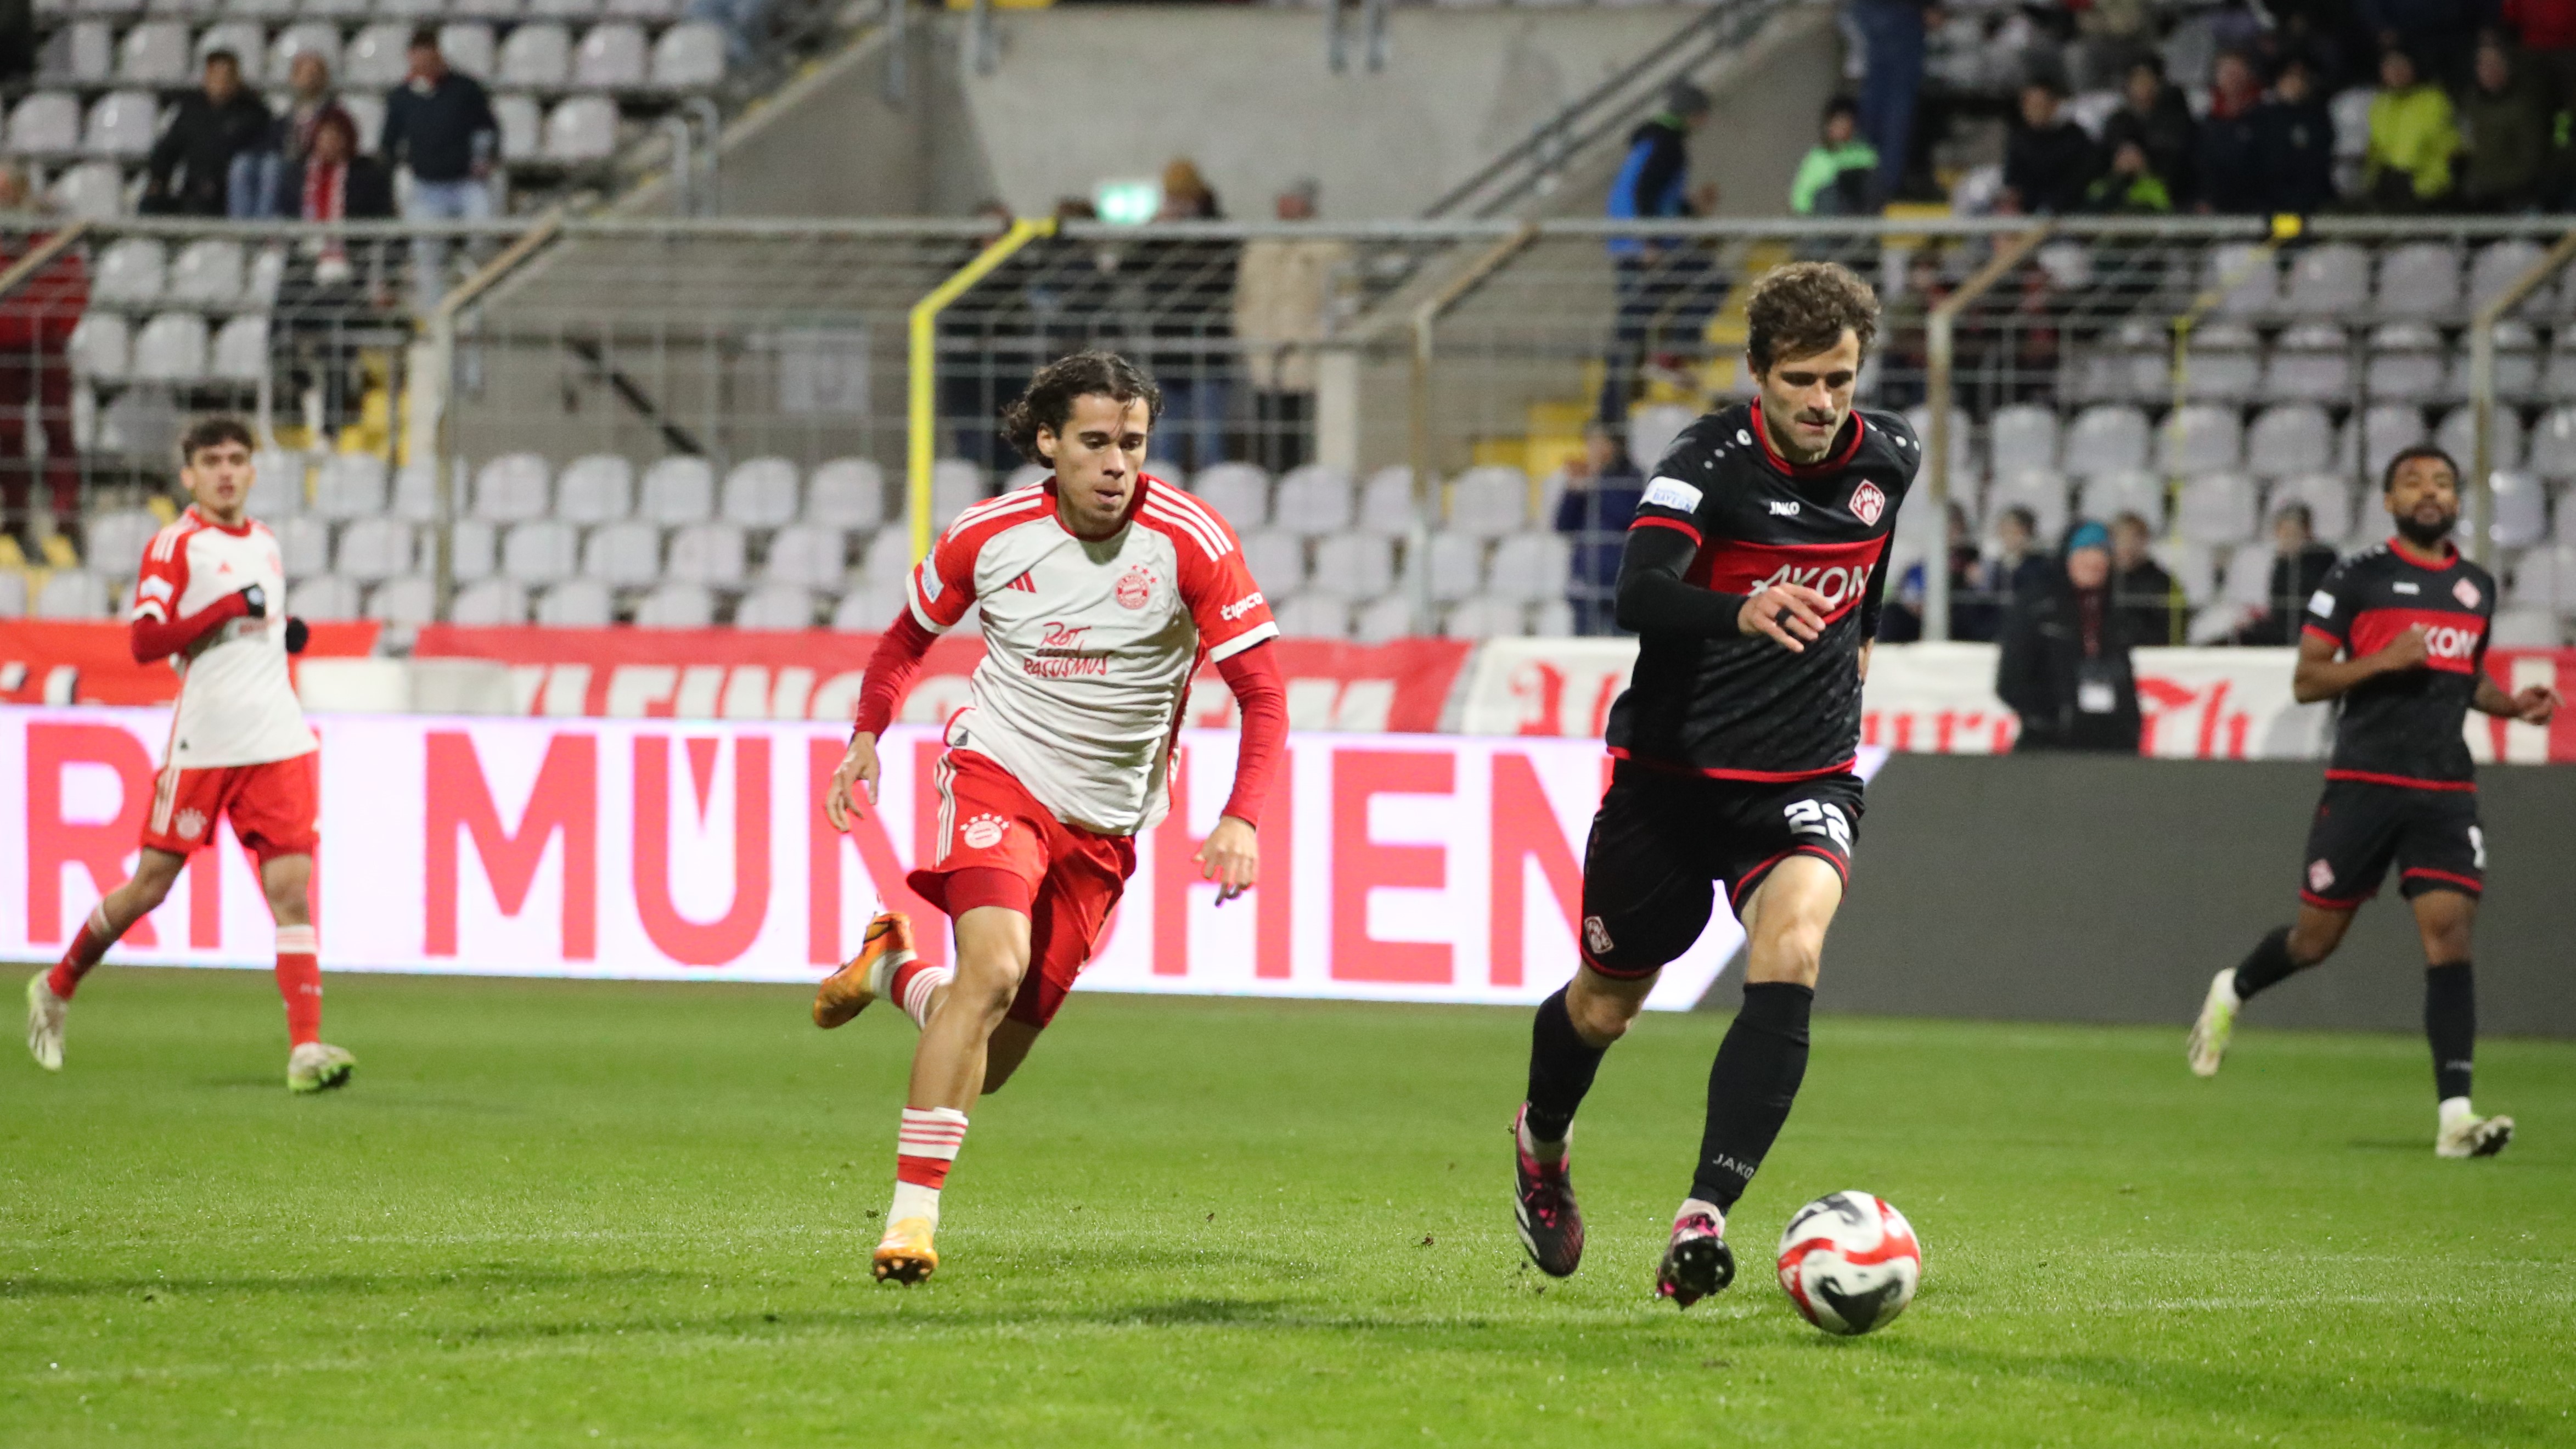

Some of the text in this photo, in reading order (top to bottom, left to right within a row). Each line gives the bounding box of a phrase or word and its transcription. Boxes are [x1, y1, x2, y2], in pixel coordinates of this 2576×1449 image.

[1769, 501, 1801, 515] JAKO
[1220, 592, 1264, 621] tipico
[1784, 799, 1851, 858] 22
[424, 732, 1615, 987] MÜNHEN
[1712, 1153, 1754, 1180] JAKO
